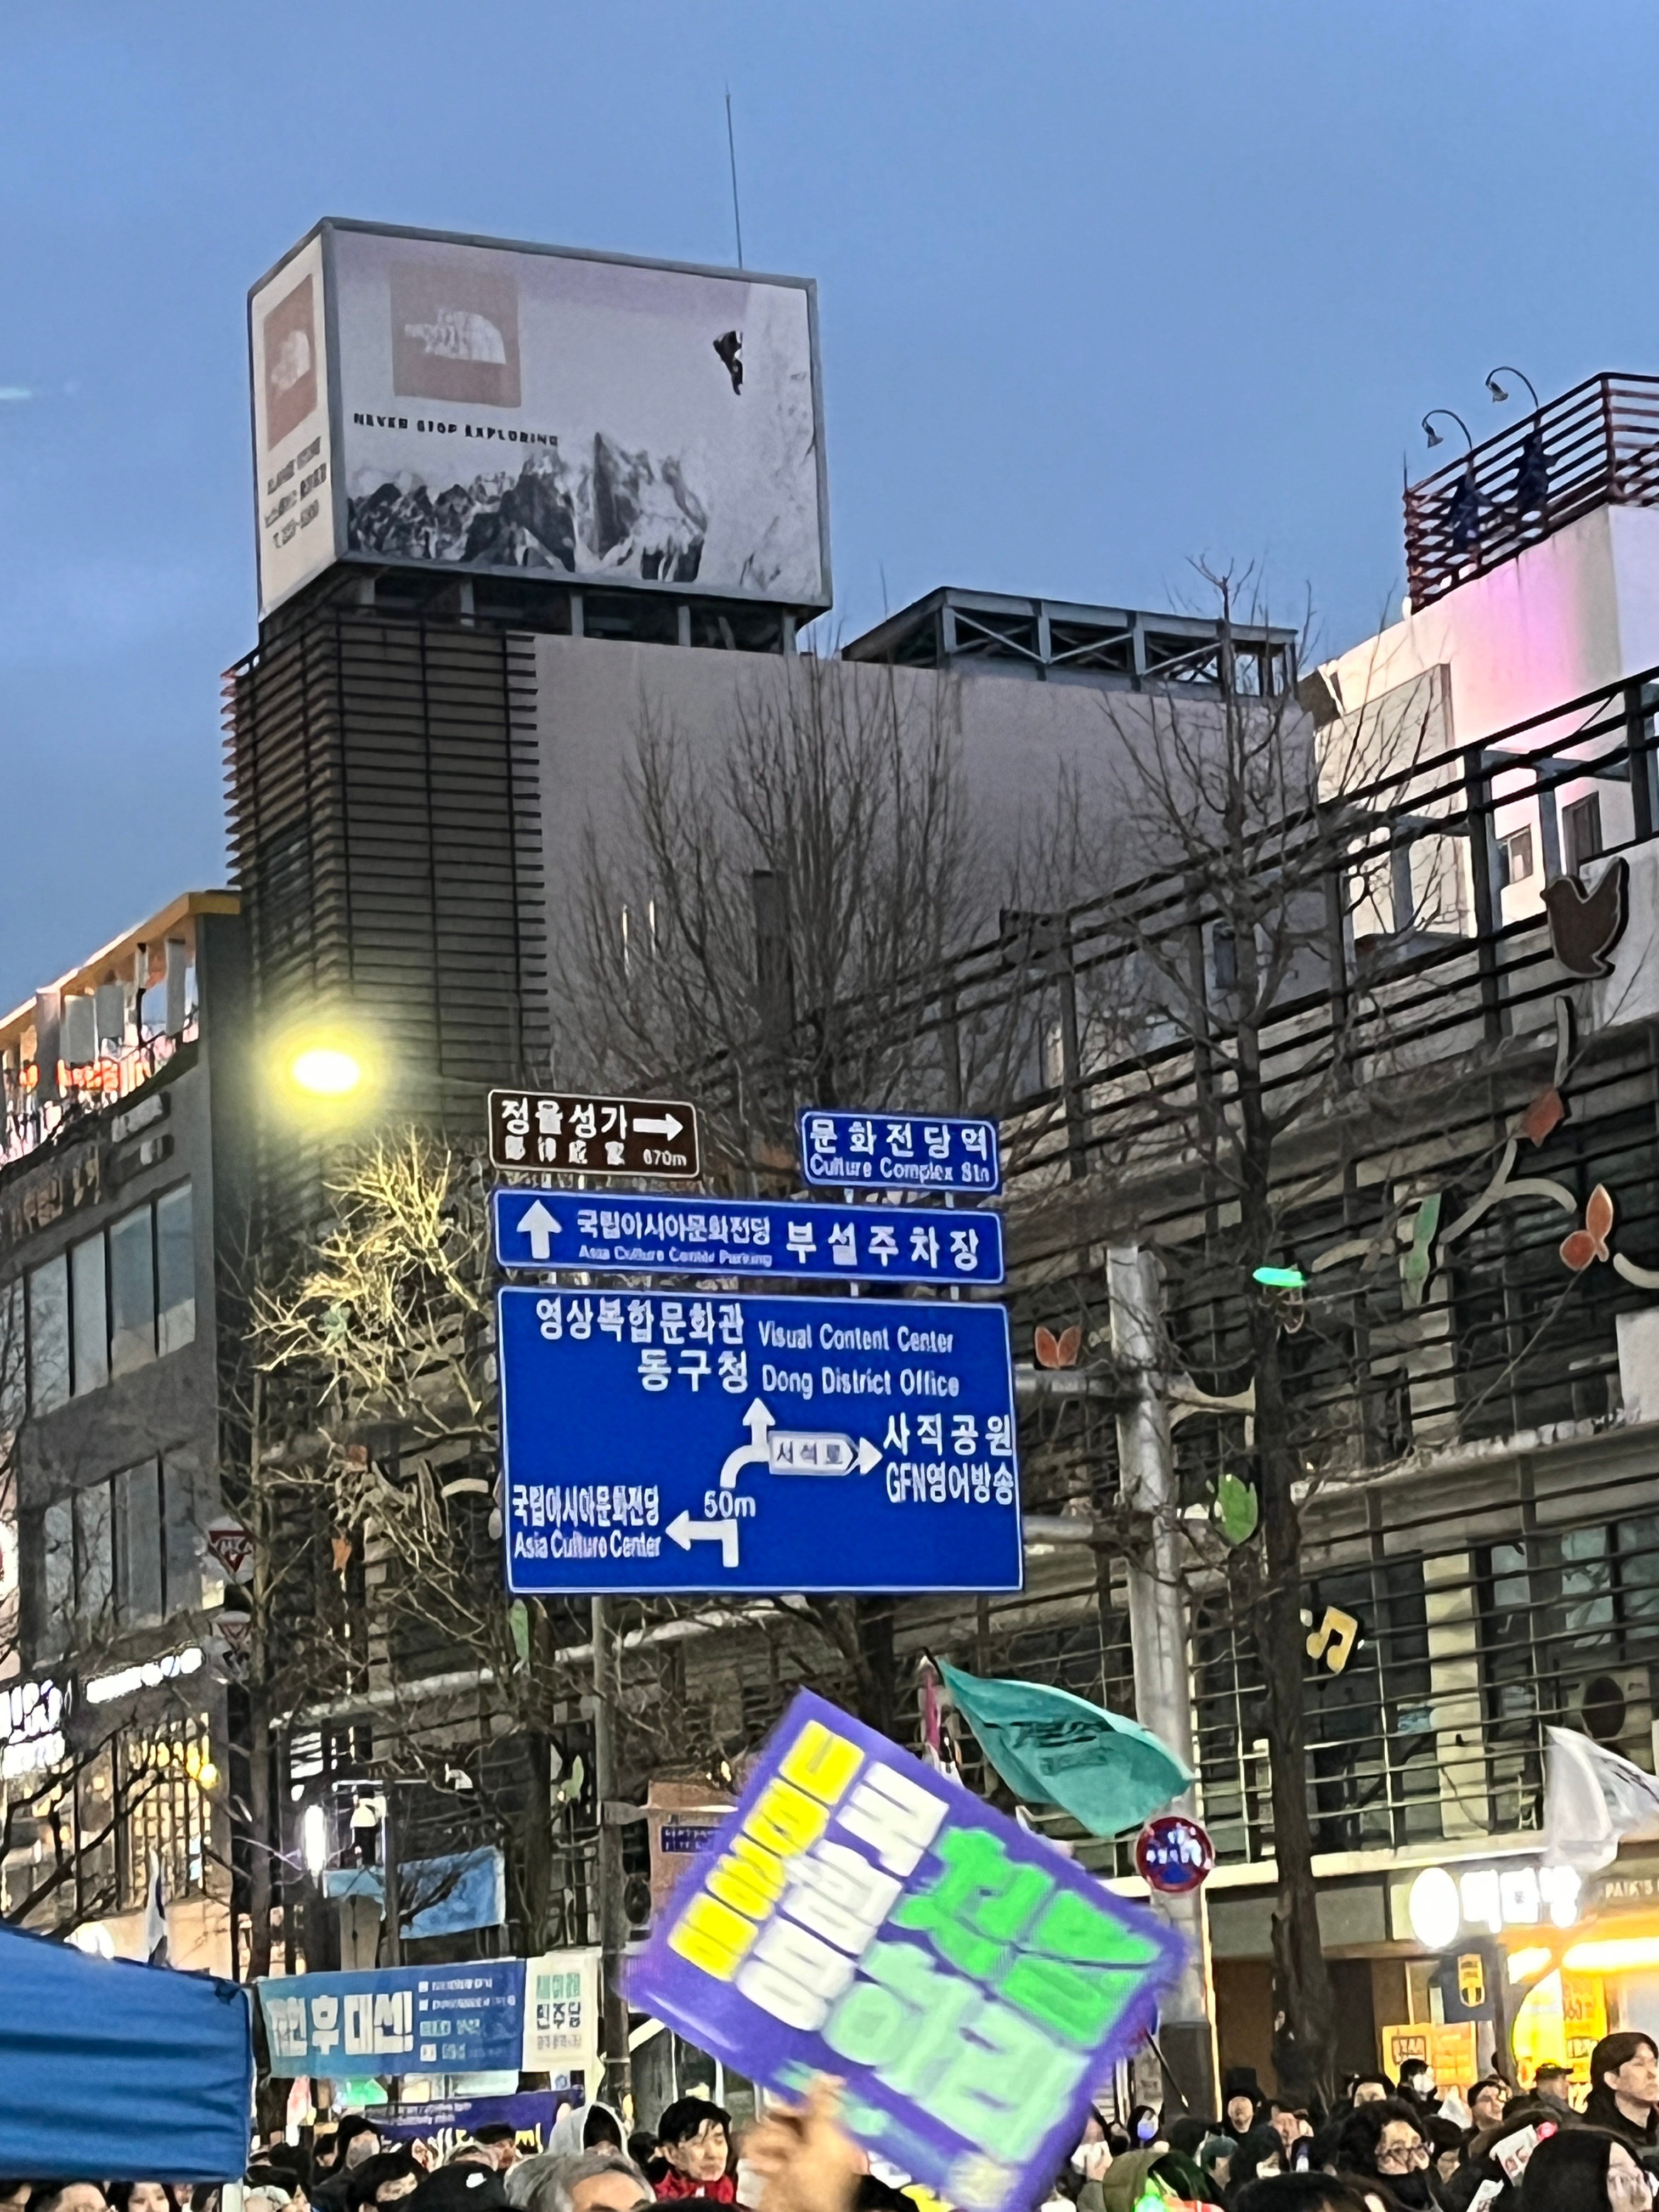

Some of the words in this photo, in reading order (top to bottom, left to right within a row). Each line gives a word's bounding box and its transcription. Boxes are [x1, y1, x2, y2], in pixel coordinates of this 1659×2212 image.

[810, 1119, 987, 1161] 문화전당역
[810, 1153, 872, 1178] Culture
[880, 1157, 953, 1183] Complex
[786, 1221, 979, 1271] 부설주차장
[536, 1296, 744, 1345] 영상복합문화관
[759, 1321, 812, 1348] Visual
[820, 1323, 889, 1350] Content
[897, 1325, 953, 1353] Center
[637, 1348, 748, 1393] 동구청
[762, 1364, 813, 1400] Dong
[822, 1366, 891, 1395] District
[900, 1368, 959, 1397] Office
[883, 1412, 1013, 1456] 사직공원
[887, 1461, 1014, 1505] GFN영어방송
[704, 1491, 757, 1518] 50m
[514, 1531, 548, 1559] Asia
[550, 1528, 607, 1559] Culture
[610, 1529, 662, 1558] Center
